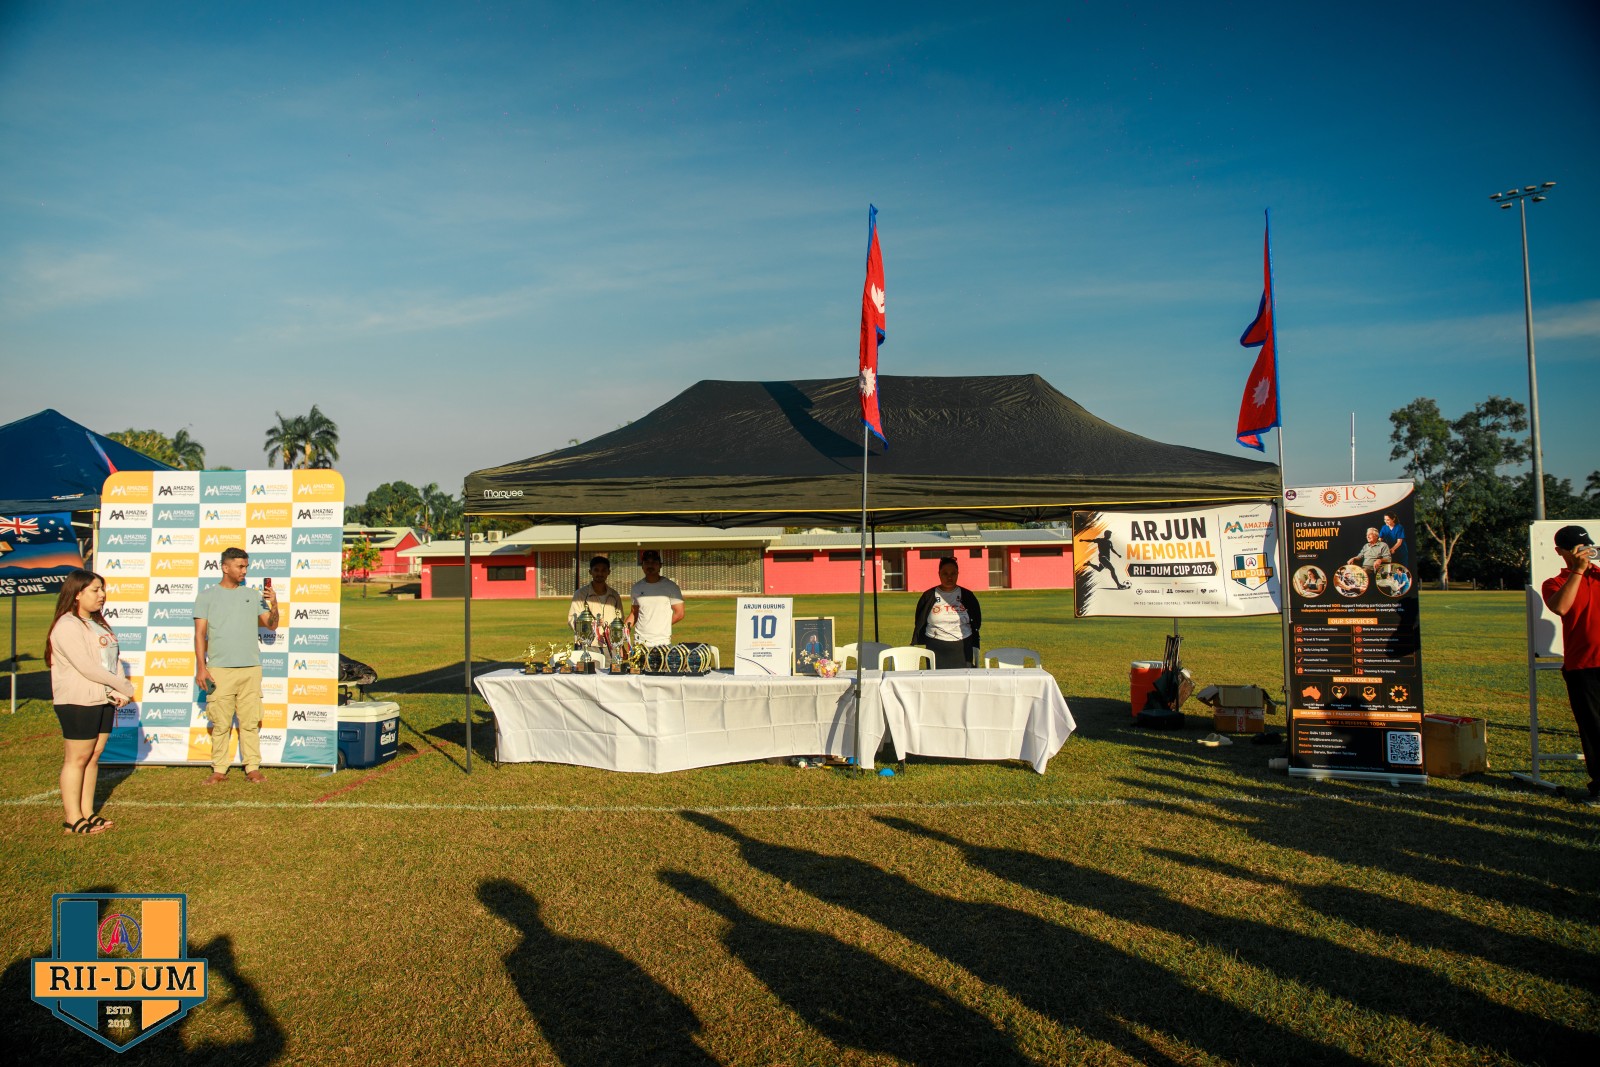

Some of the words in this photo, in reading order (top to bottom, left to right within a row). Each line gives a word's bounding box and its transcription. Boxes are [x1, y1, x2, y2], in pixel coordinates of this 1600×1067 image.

[484, 489, 523, 499] Marquee
[1340, 486, 1376, 500] TCS
[1131, 517, 1206, 541] ARJUN
[1296, 528, 1339, 538] COMMUNITY
[1126, 541, 1215, 560] MEMORIAL
[1296, 541, 1328, 550] SUPPORT
[1133, 566, 1171, 576] RII-DUM
[1174, 565, 1191, 575] CUP
[1192, 564, 1213, 574] 2026
[1234, 569, 1270, 577] RII-DUM
[18, 584, 46, 593] ONE
[751, 615, 777, 639] 10
